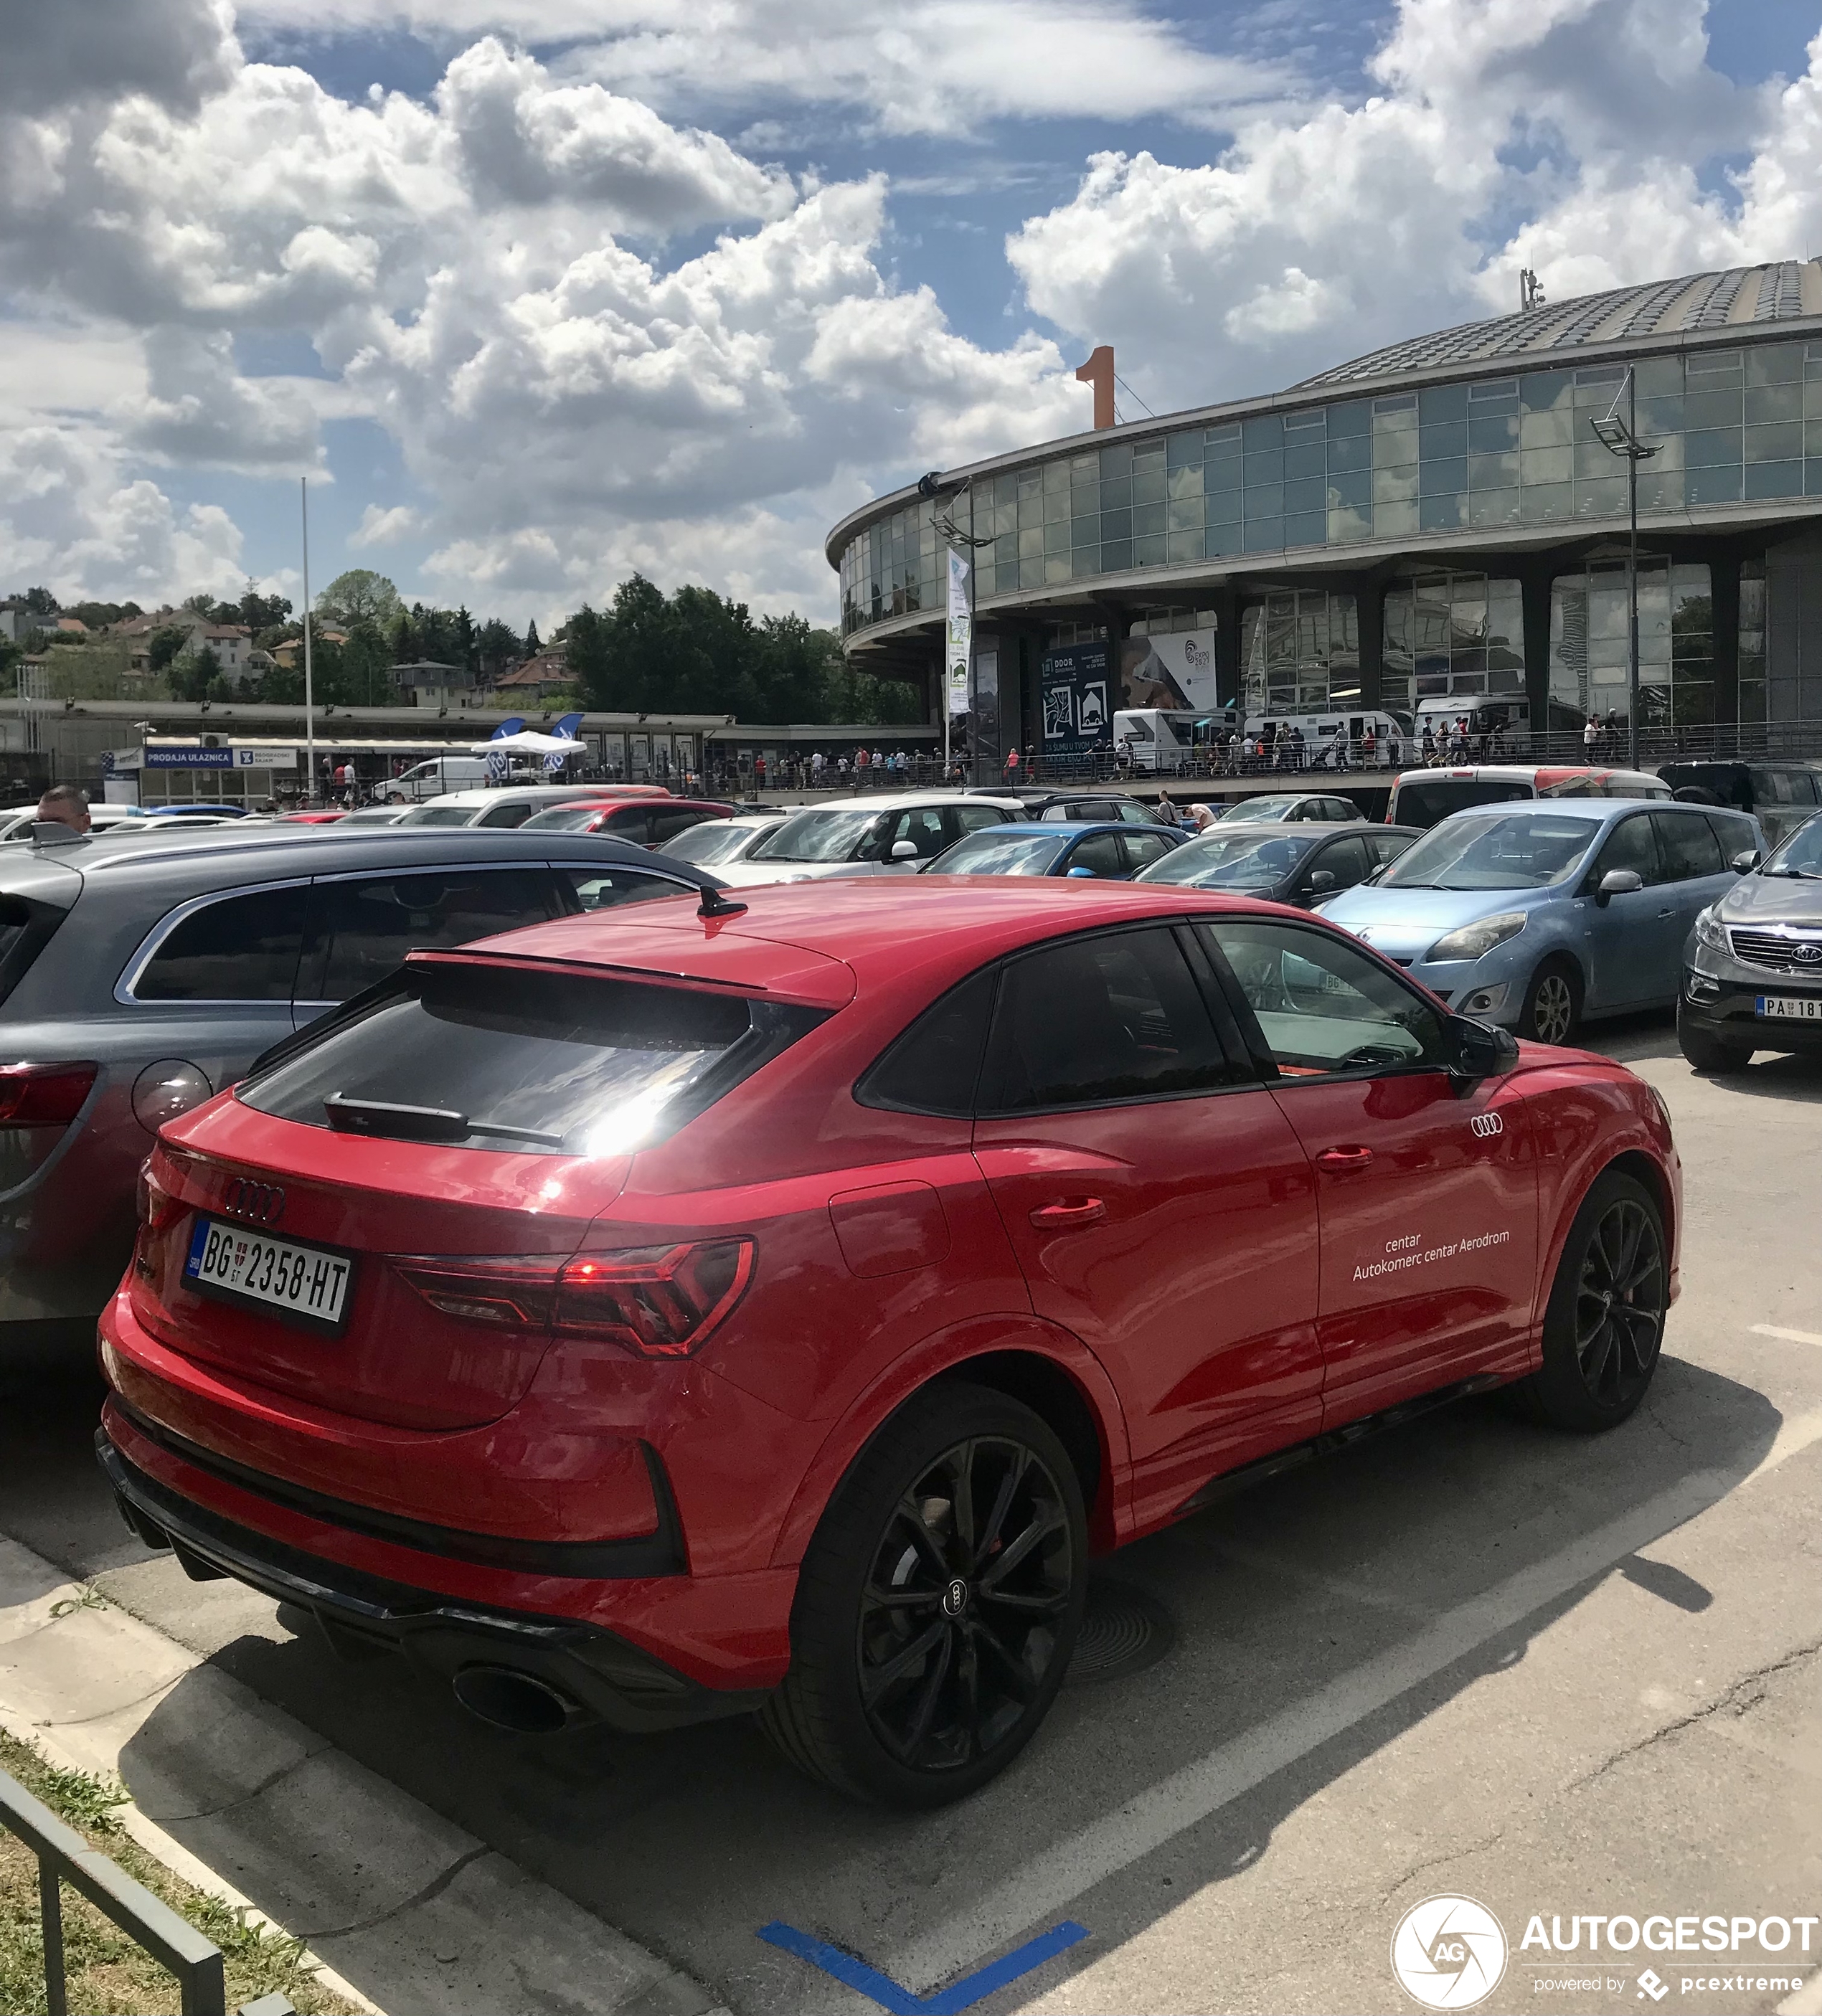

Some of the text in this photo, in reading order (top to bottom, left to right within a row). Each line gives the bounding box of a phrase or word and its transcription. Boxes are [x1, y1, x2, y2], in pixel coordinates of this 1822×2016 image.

[1075, 344, 1115, 430] 1
[1054, 658, 1072, 668] DDOR
[148, 753, 187, 762] PRODAJA
[188, 753, 230, 762] ULAZNICA
[1796, 948, 1818, 960] KIA
[1767, 999, 1785, 1015] PA
[1385, 1234, 1421, 1253] centar
[203, 1229, 234, 1279] BG
[1352, 1231, 1509, 1282] Autokomerc centar Aerodrom
